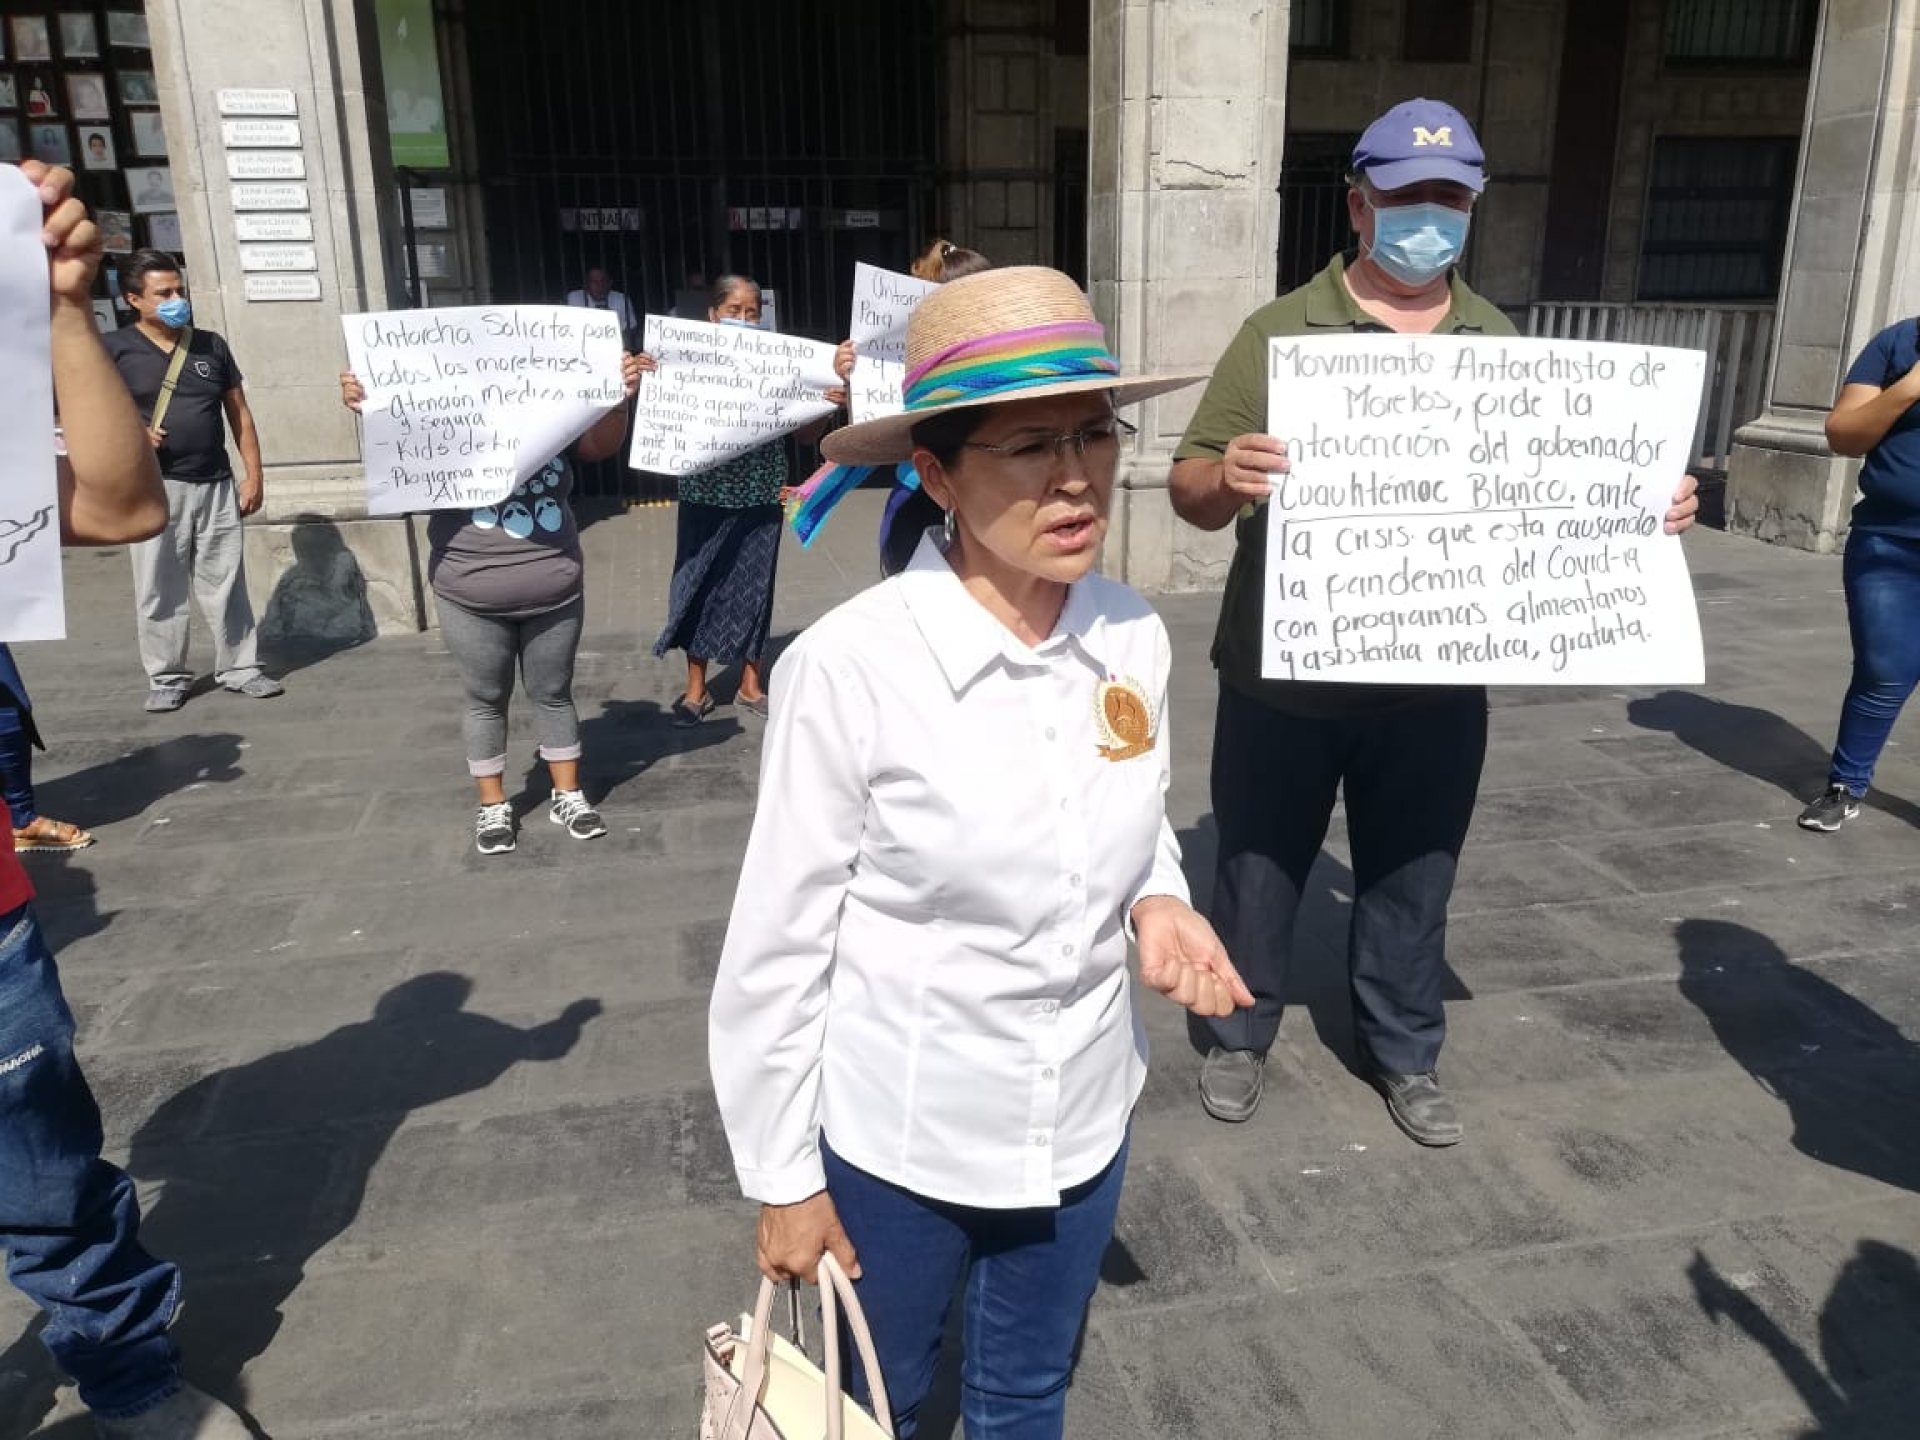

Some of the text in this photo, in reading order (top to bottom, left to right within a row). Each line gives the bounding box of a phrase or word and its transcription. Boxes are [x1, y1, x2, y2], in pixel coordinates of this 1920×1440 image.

[1413, 126, 1453, 146] M
[581, 323, 620, 358] para
[648, 319, 728, 348] Movimiento
[360, 346, 592, 387] todos los morelenses
[1272, 341, 1666, 389] Movimiento Antorchista de
[1343, 384, 1594, 434] Morelos, pide la
[396, 432, 450, 461] Kids
[459, 427, 486, 456] de
[1468, 430, 1509, 465] del
[1523, 421, 1667, 478] gobernador
[1587, 472, 1642, 509] ante
[1281, 522, 1312, 561] la
[1427, 523, 1477, 561] que
[1488, 511, 1545, 542] esta
[1558, 507, 1657, 540] causando
[1279, 544, 1643, 613] la pandemia del Covid-19
[1274, 619, 1318, 642] con
[1333, 602, 1488, 648] programas
[1280, 649, 1296, 681] y
[1302, 634, 1423, 671] asistencia
